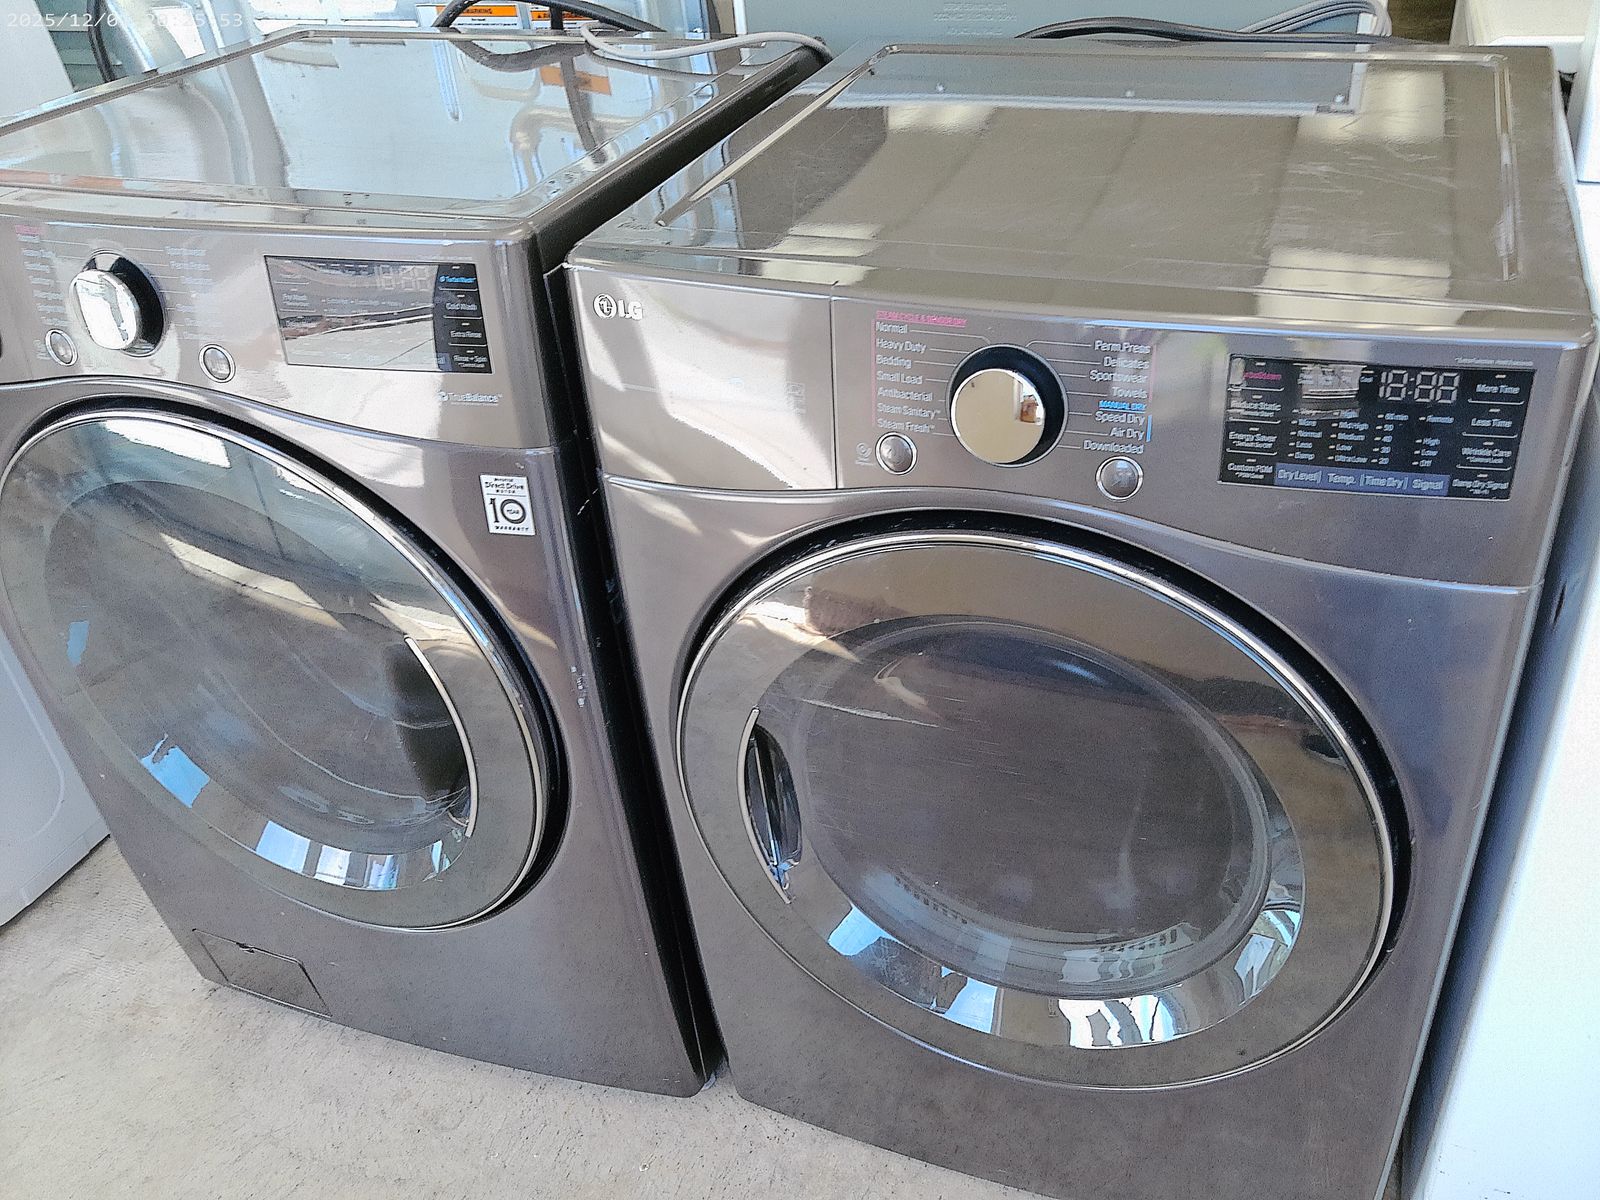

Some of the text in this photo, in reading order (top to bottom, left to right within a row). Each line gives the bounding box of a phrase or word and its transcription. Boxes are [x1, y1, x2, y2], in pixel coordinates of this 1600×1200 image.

[617, 299, 643, 321] LG
[876, 321, 909, 334] Normal
[876, 338, 927, 355] Heavy Duty
[1122, 342, 1151, 354] Press
[876, 354, 912, 369] Bedding
[1103, 356, 1150, 370] Delicates
[876, 370, 923, 385] Small Load
[1089, 370, 1148, 385] Sportswear
[877, 387, 933, 402] Antibacterial
[1111, 386, 1148, 399] Towels
[1475, 384, 1521, 395] More Time
[876, 402, 903, 414] Steam
[1257, 401, 1282, 411] Static
[877, 418, 905, 431] Steam
[1095, 411, 1146, 426] Speed Dry
[1298, 418, 1317, 427] More
[1471, 418, 1513, 428] Less Time
[1109, 427, 1145, 441] Air Dry
[1228, 431, 1278, 442] Energy Saver
[1296, 430, 1323, 439] Normal
[1381, 435, 1393, 443] 40
[1083, 440, 1145, 454] Downloaded
[1295, 441, 1313, 449] Less
[1335, 443, 1353, 451] Low
[1380, 446, 1392, 454] 30
[1420, 448, 1439, 457] Low
[1461, 447, 1512, 458] Wrinkle Care
[1378, 457, 1390, 465] 20
[1227, 462, 1255, 473] Custom
[1277, 469, 1318, 482] Dry Level
[1327, 472, 1357, 485] Temp.
[1365, 475, 1404, 489] Time Dry
[1412, 478, 1444, 490] Signal
[1486, 481, 1510, 490] Signal
[488, 497, 527, 524] 10
